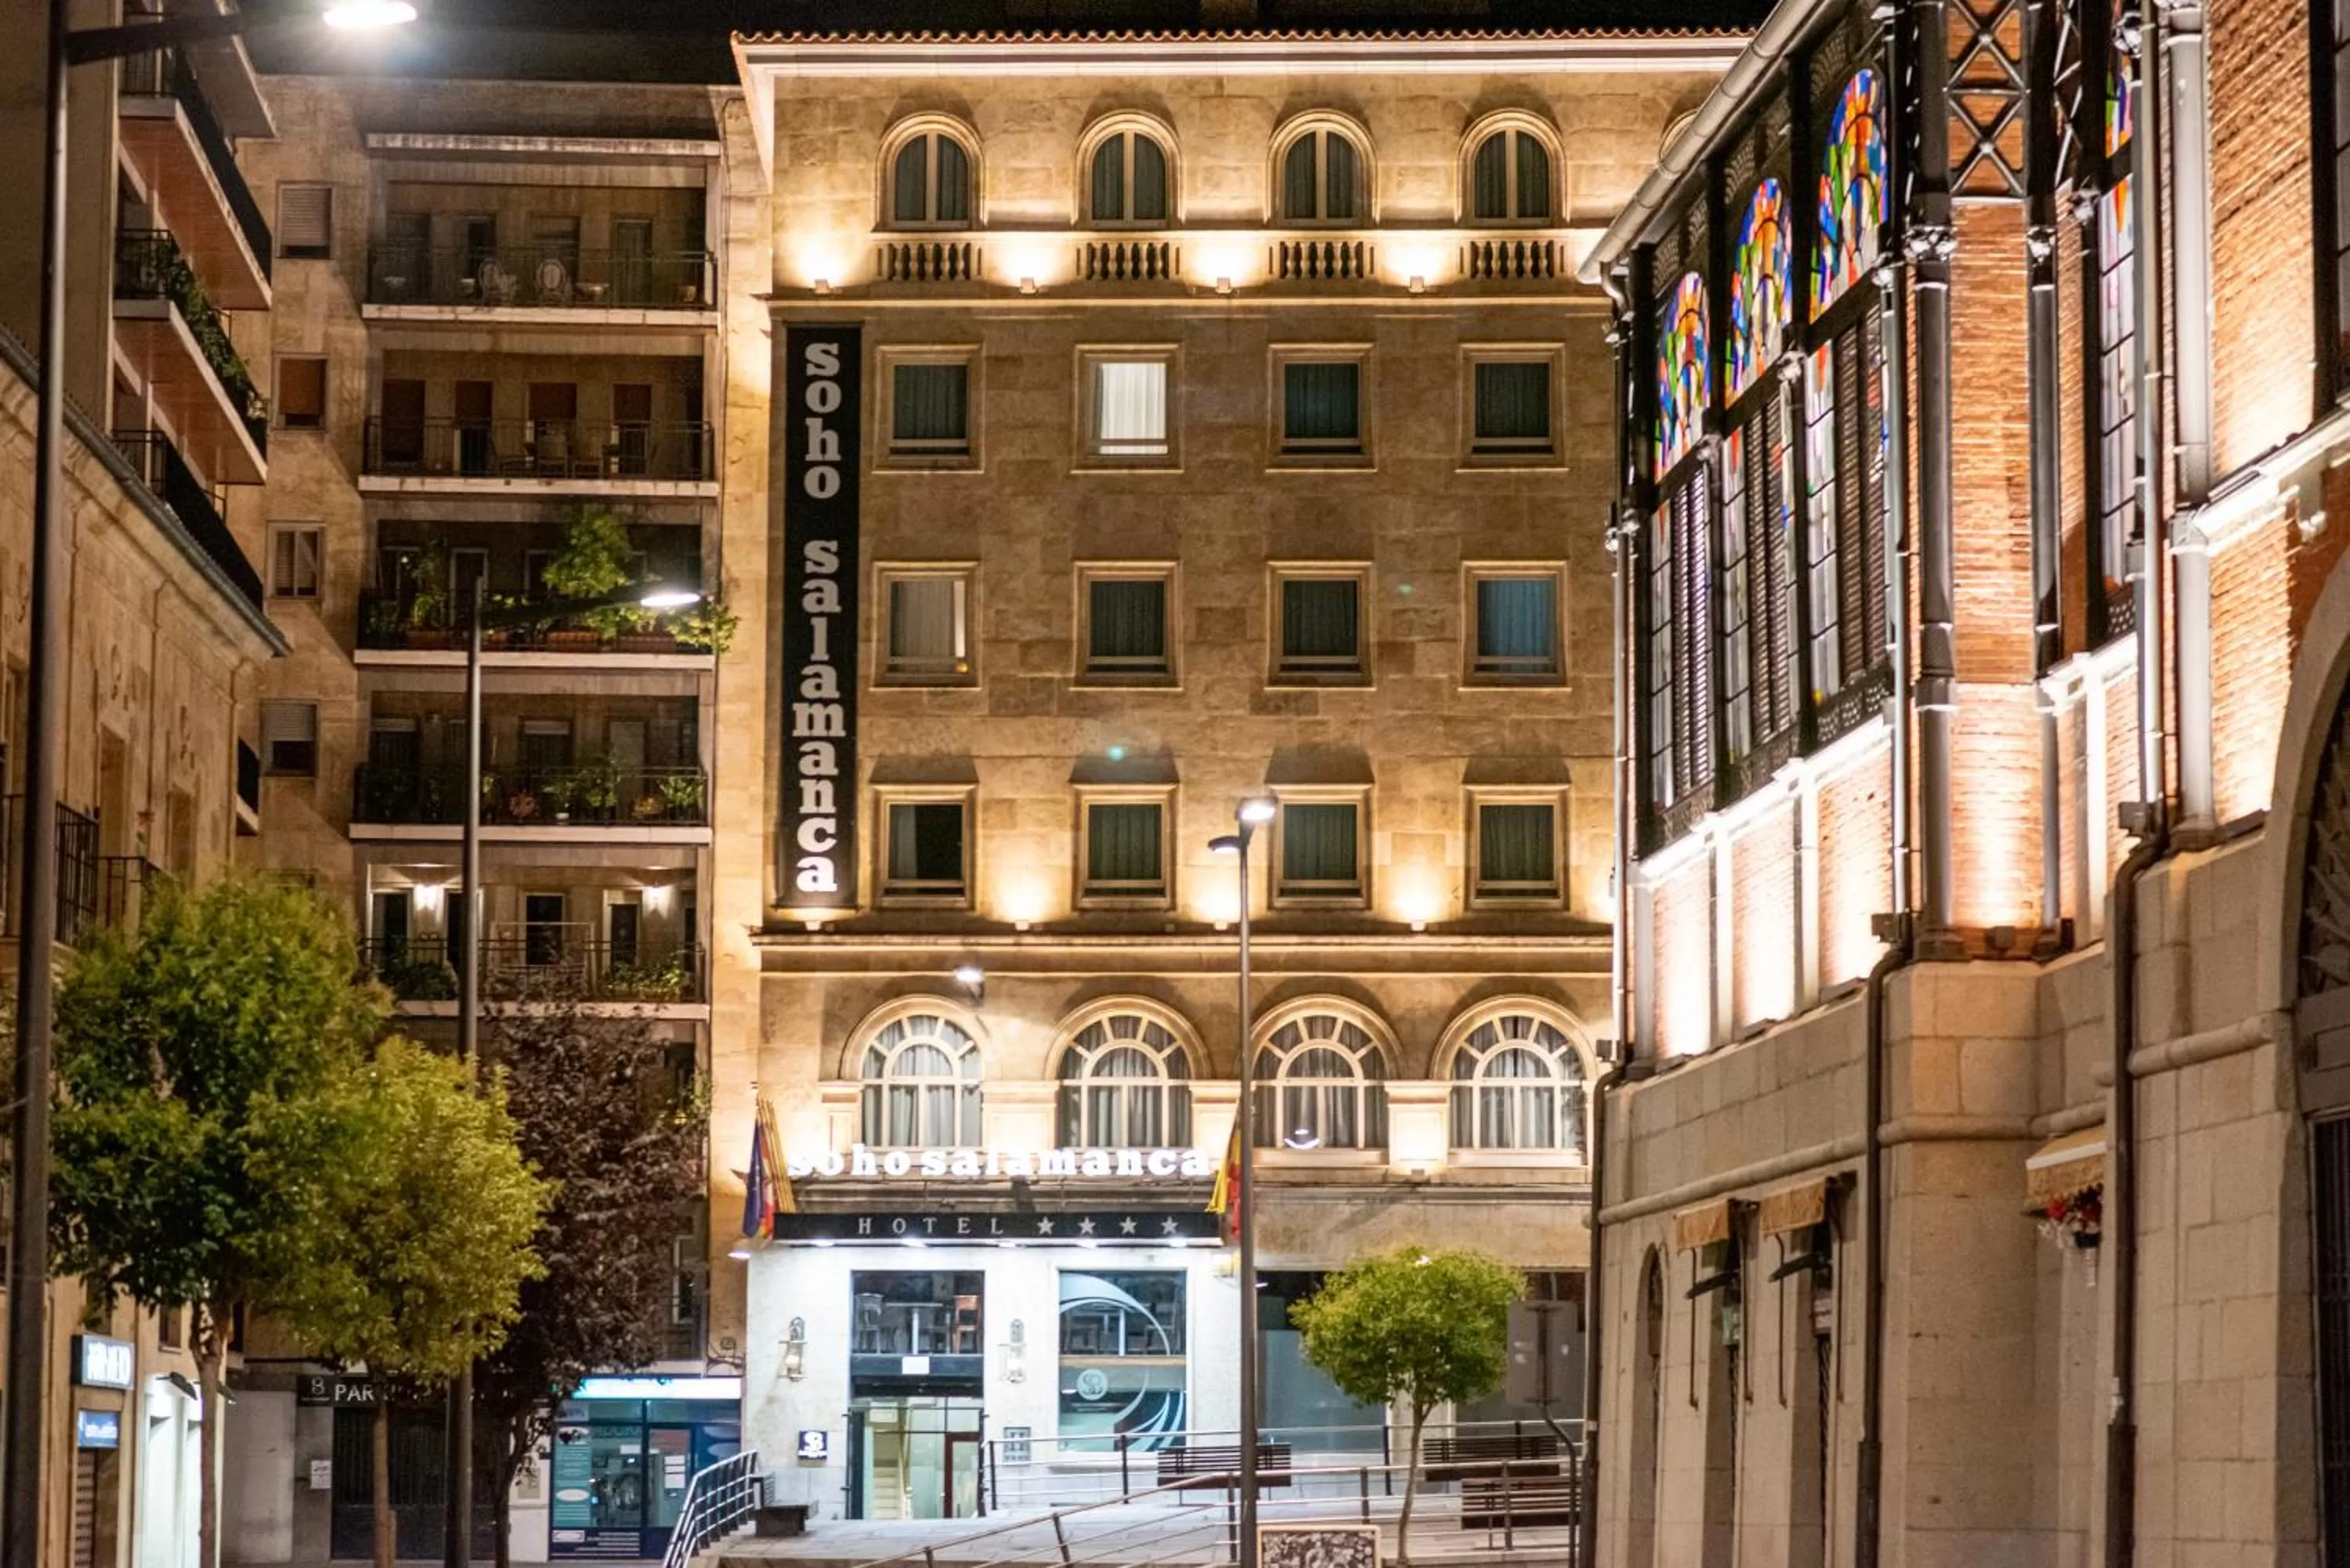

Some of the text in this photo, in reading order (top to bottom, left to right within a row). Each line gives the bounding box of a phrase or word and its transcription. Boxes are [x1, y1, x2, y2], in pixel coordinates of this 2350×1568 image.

[792, 342, 846, 892] soho salamanca
[786, 1143, 1210, 1176] soho salamanca
[858, 1216, 1003, 1235] HOTEL
[334, 1383, 374, 1402] PAR
